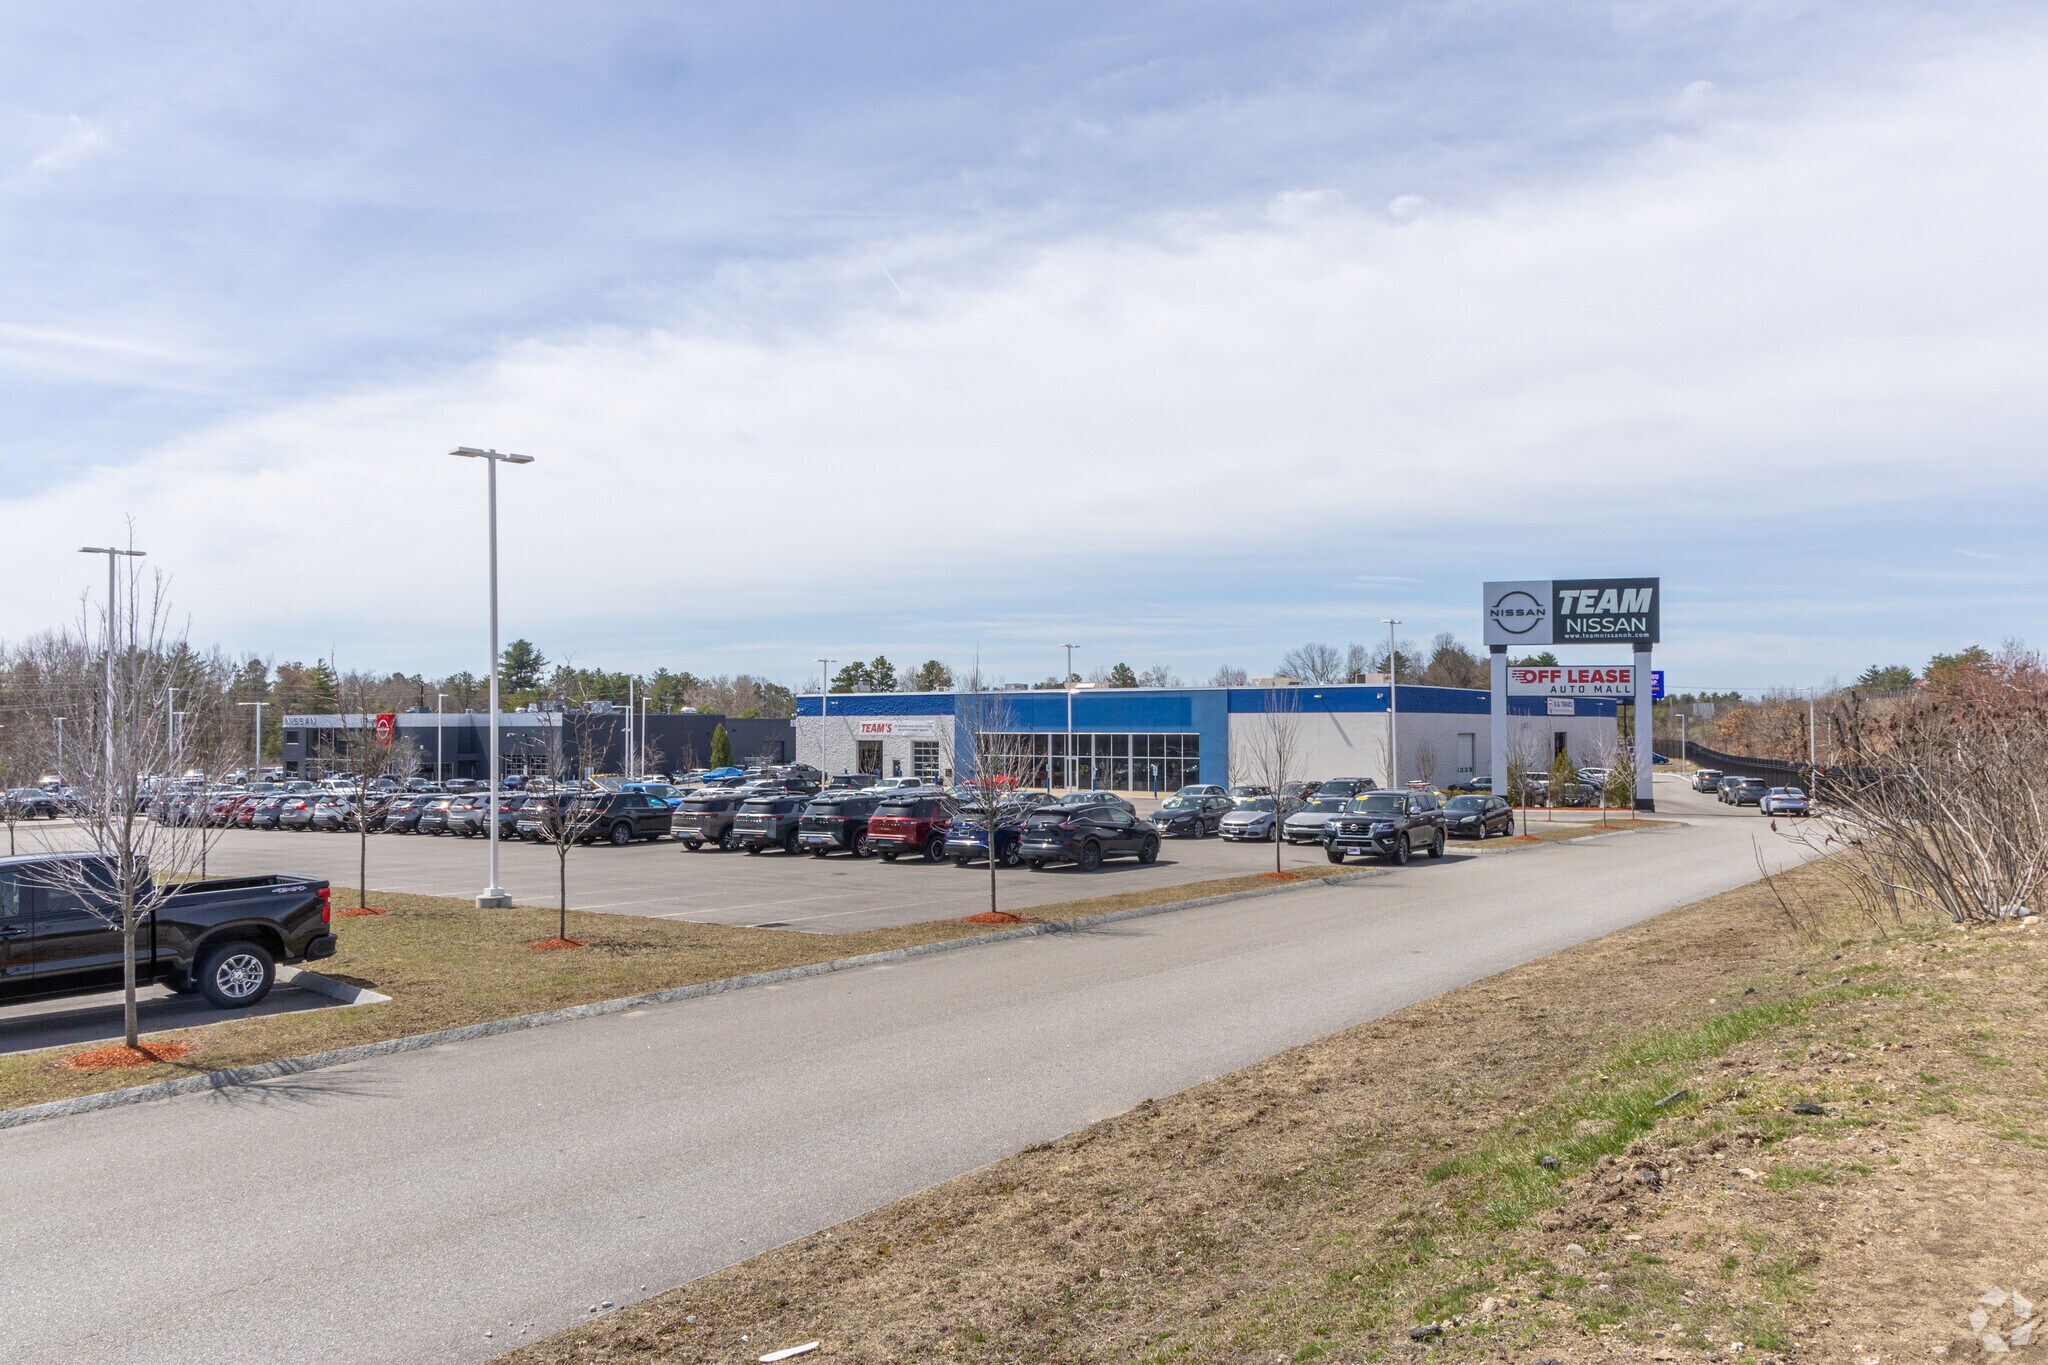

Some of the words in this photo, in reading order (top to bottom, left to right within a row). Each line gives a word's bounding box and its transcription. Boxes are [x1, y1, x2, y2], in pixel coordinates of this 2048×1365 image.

[1559, 588, 1653, 615] TEAM
[1490, 608, 1546, 617] NISSAN
[1566, 617, 1647, 632] NISSAN
[1514, 669, 1562, 684] OFF
[1567, 669, 1631, 684] LEASE
[1550, 685, 1585, 694] AUTO
[1594, 685, 1631, 694] MALL
[285, 717, 317, 726] NISSAN
[861, 723, 893, 733] TEAM'S
